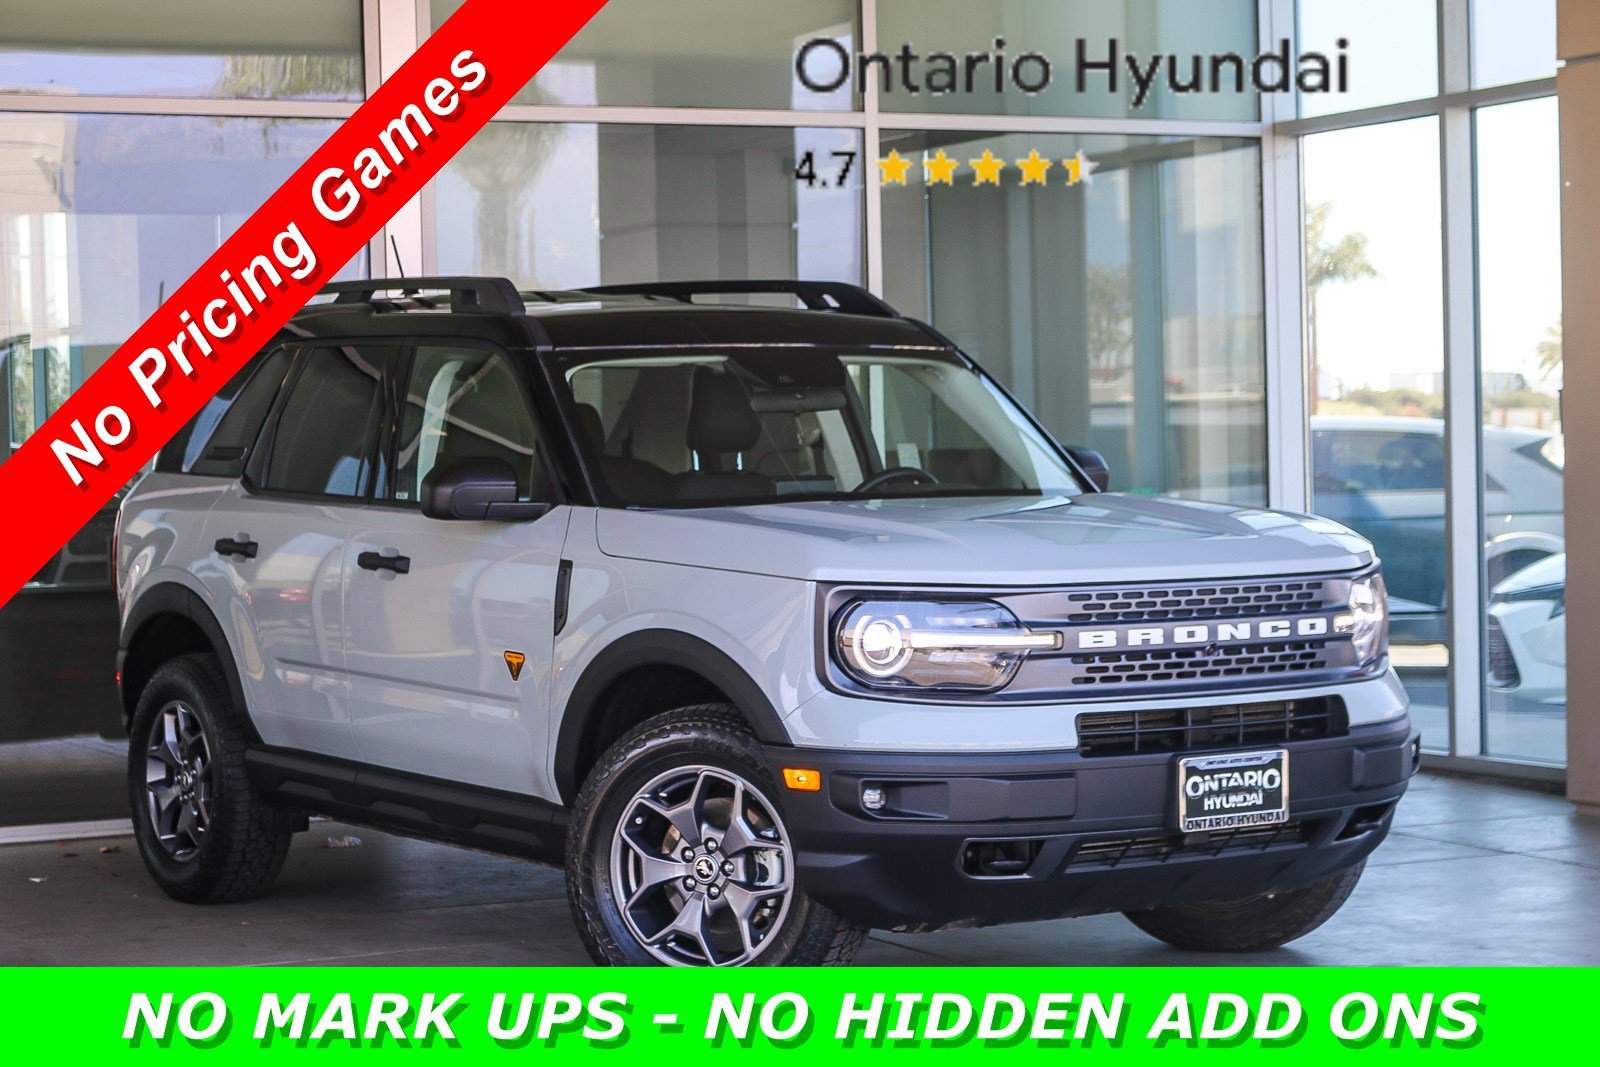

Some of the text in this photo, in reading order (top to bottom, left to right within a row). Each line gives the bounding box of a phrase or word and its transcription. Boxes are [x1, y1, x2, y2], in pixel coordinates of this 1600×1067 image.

[1077, 616, 1328, 649] BRONCO
[1185, 768, 1281, 799] ONTARIO
[1203, 789, 1264, 811] HYUNDAI
[1186, 811, 1286, 831] ONTARIO HYUNDAI
